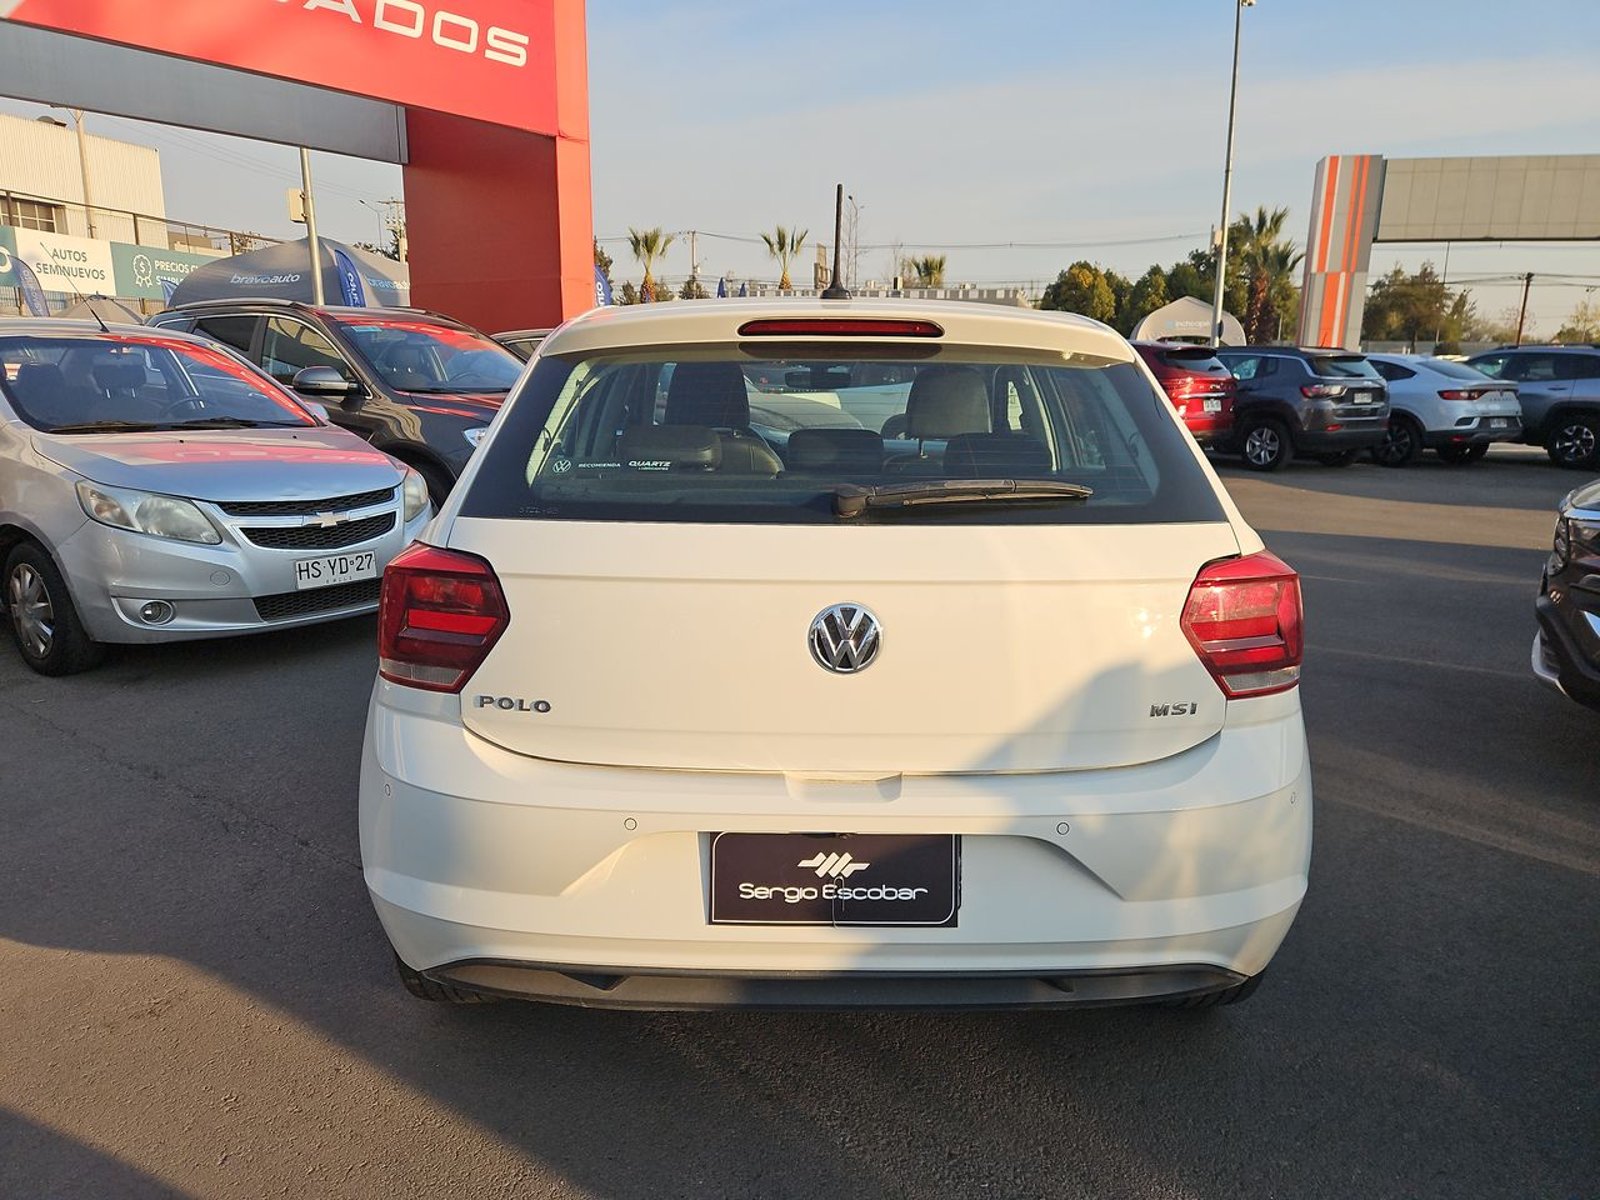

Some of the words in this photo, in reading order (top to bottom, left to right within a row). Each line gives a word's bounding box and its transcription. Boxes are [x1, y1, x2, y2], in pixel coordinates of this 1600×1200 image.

[275, 0, 530, 67] ADOS
[52, 247, 88, 263] AUTOS
[36, 262, 105, 280] SEMINUEVOS
[154, 260, 190, 273] PRECIOS
[230, 273, 300, 284] bravoauto
[474, 695, 552, 713] POLO
[1149, 702, 1198, 717] MSI
[738, 882, 818, 904] Sergio
[821, 883, 929, 901] Escobar
